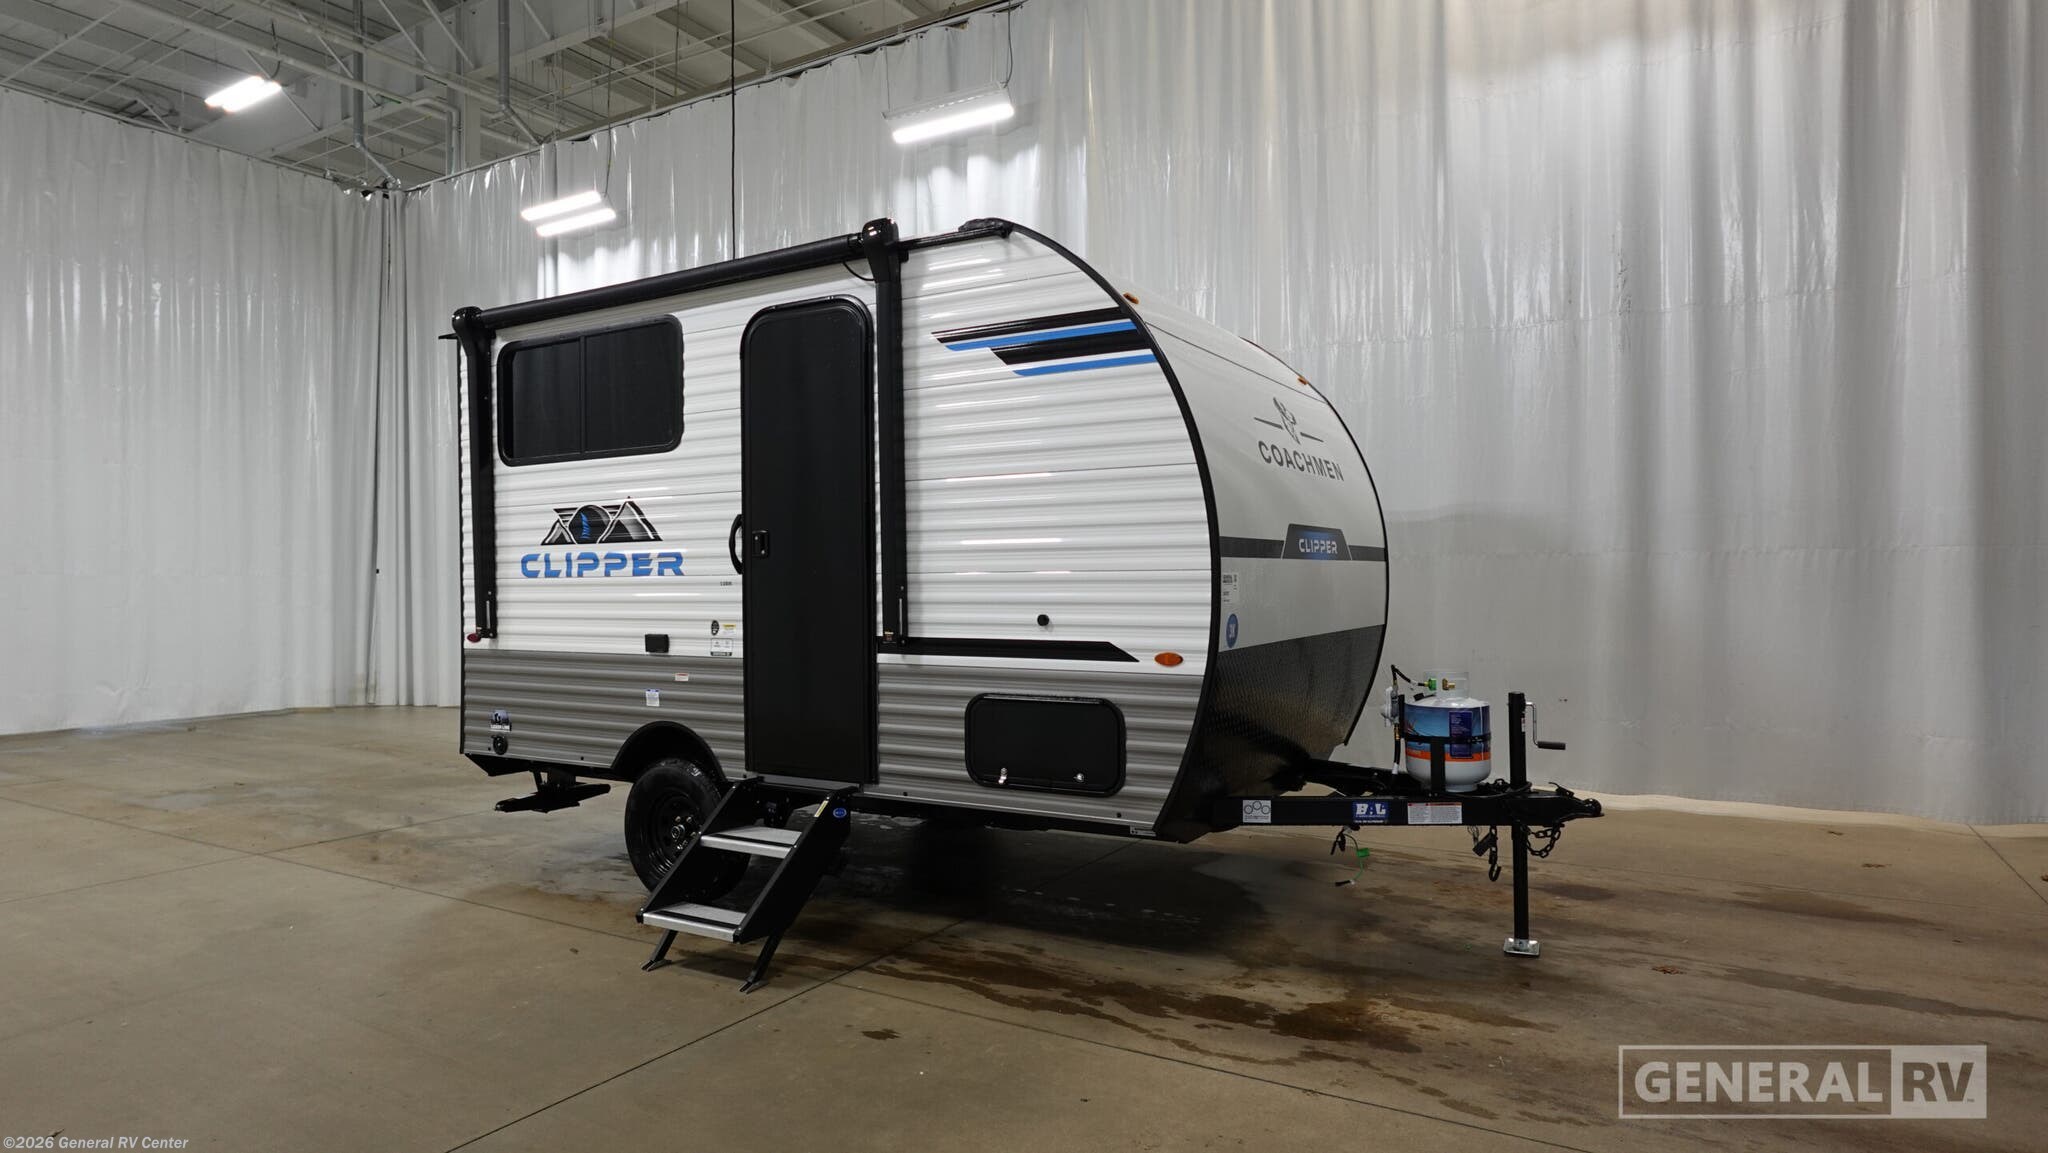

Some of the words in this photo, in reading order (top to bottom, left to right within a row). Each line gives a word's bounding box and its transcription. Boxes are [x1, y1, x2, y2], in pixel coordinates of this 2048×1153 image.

[1258, 440, 1344, 481] COACHMEN
[1298, 538, 1338, 554] CLIPPER
[521, 551, 685, 579] CLIPPER
